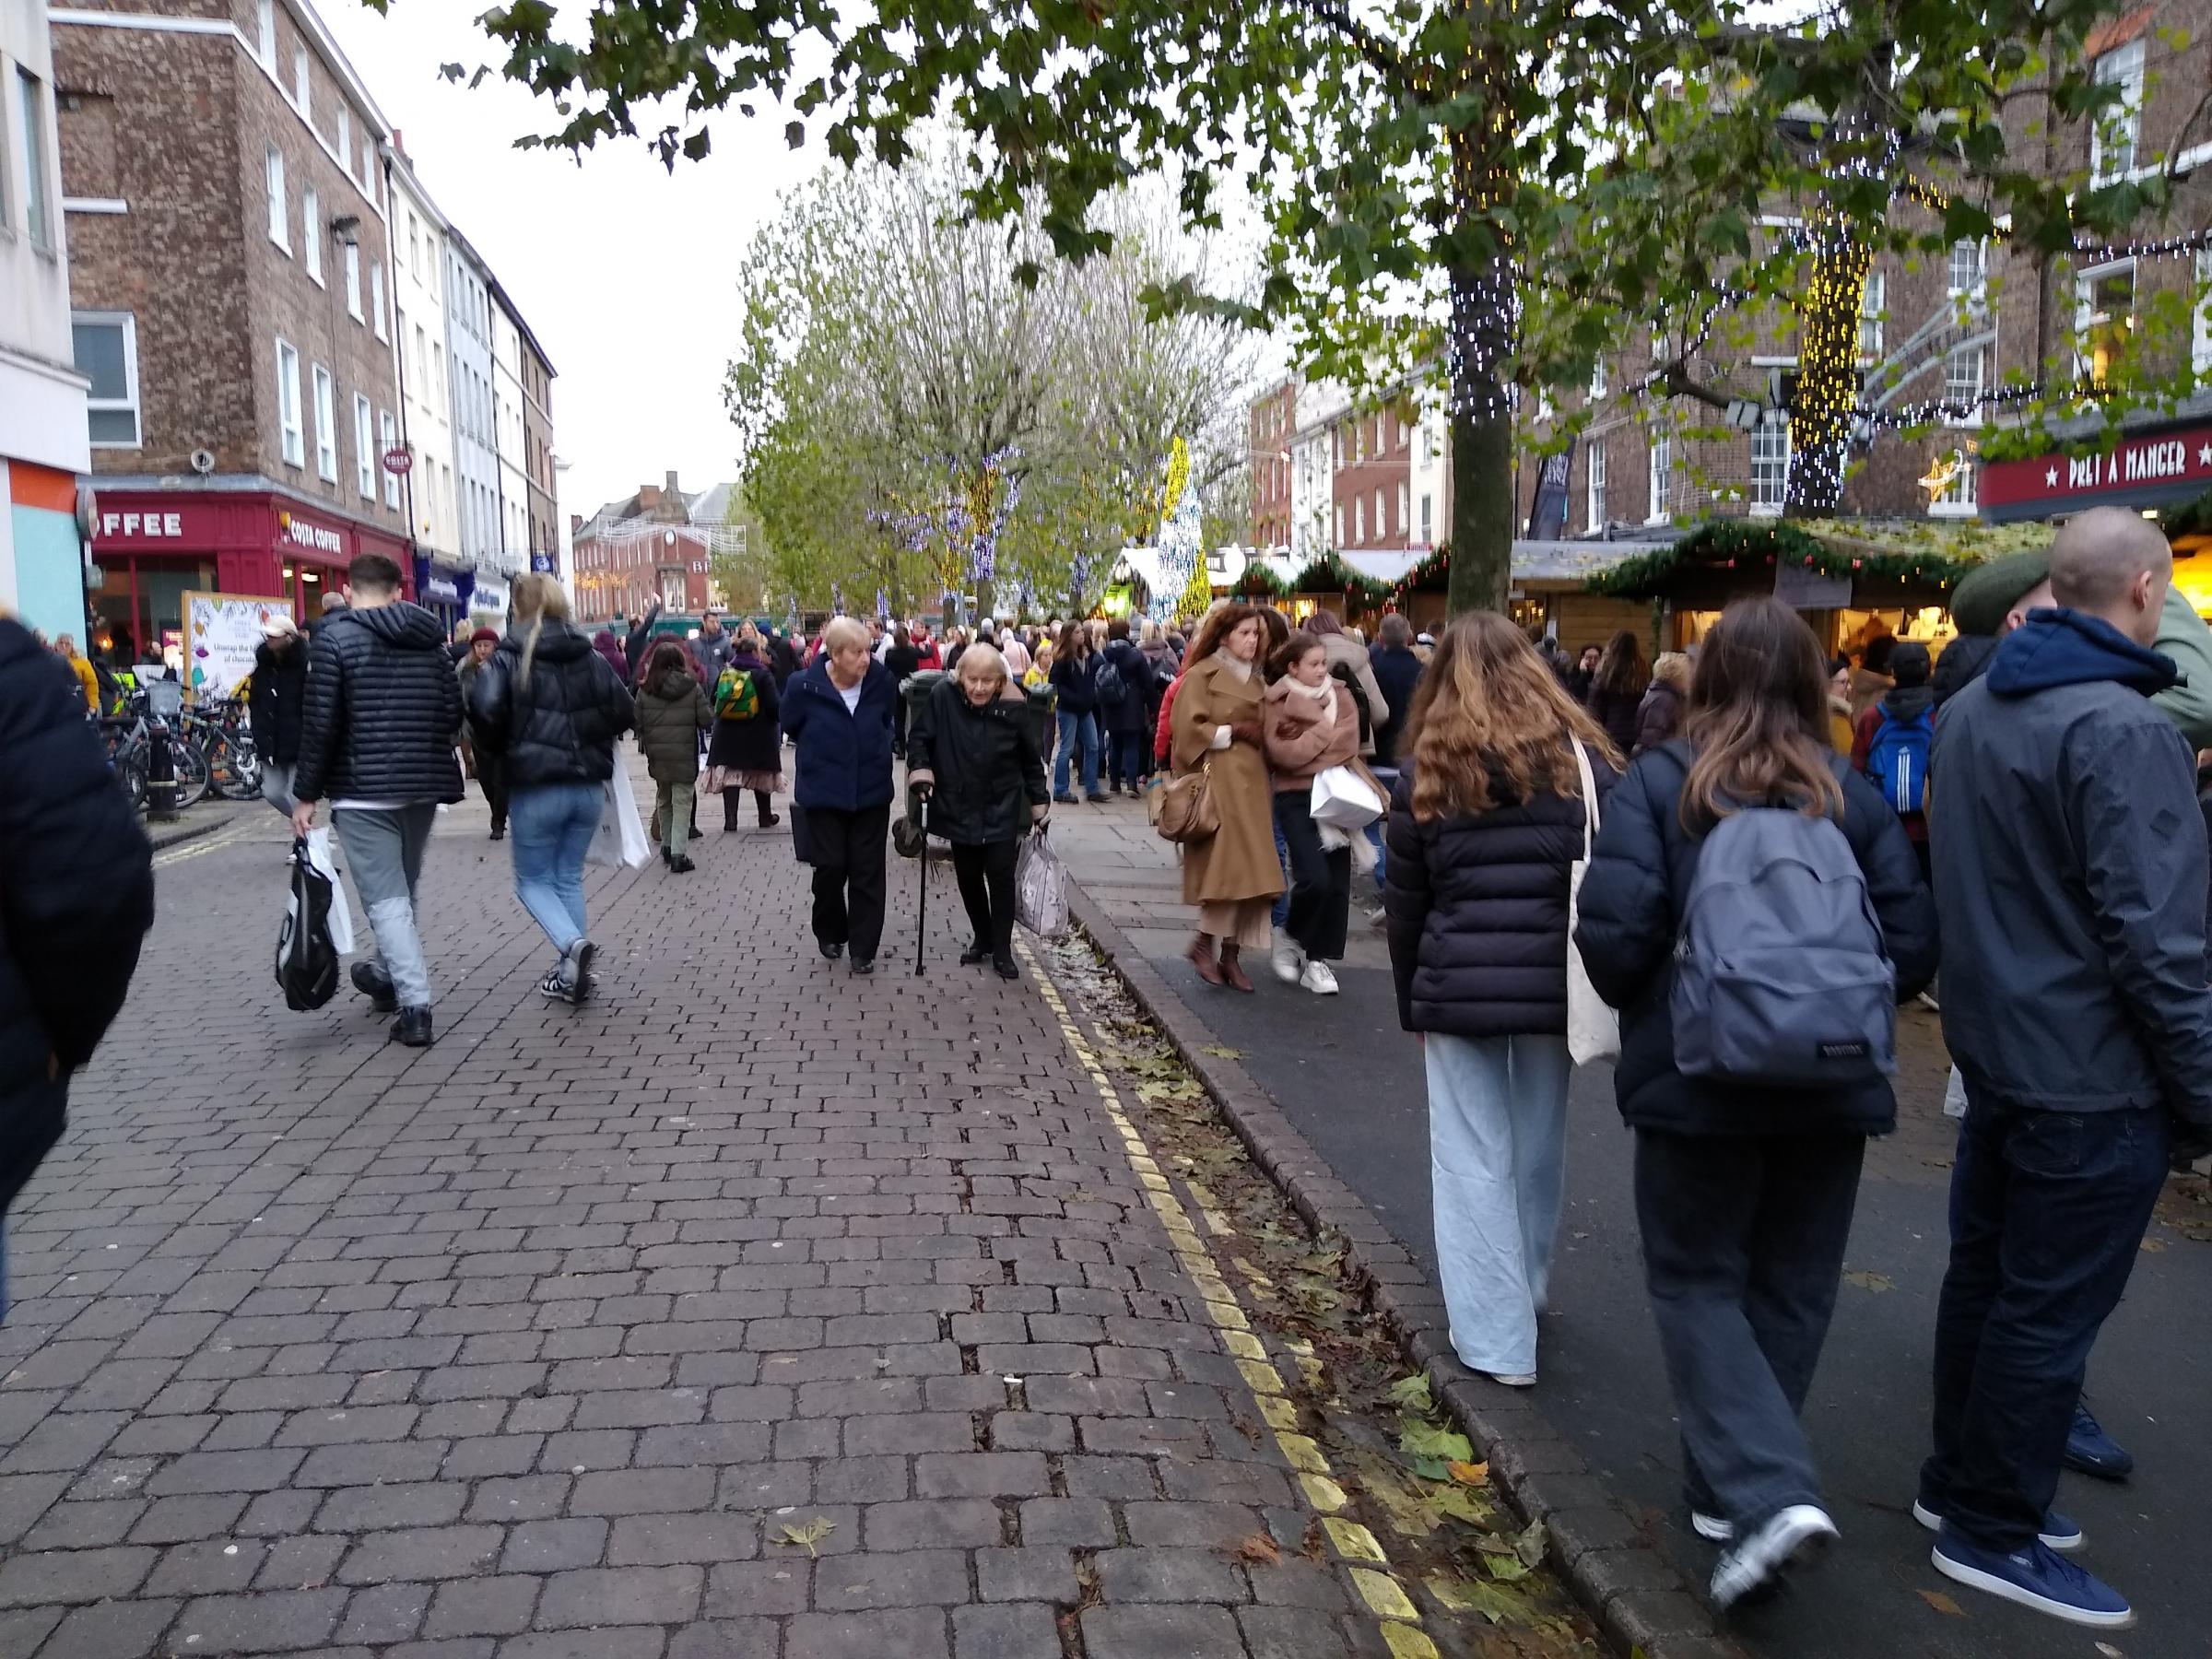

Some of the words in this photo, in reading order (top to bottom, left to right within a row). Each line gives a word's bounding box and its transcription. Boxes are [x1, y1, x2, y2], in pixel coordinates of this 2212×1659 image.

[2068, 452, 2101, 489] PRET
[2108, 450, 2118, 484] A
[2125, 440, 2186, 481] MANGER
[97, 512, 182, 537] FFEE
[290, 519, 315, 548] COSTA
[314, 527, 342, 554] COFFEE
